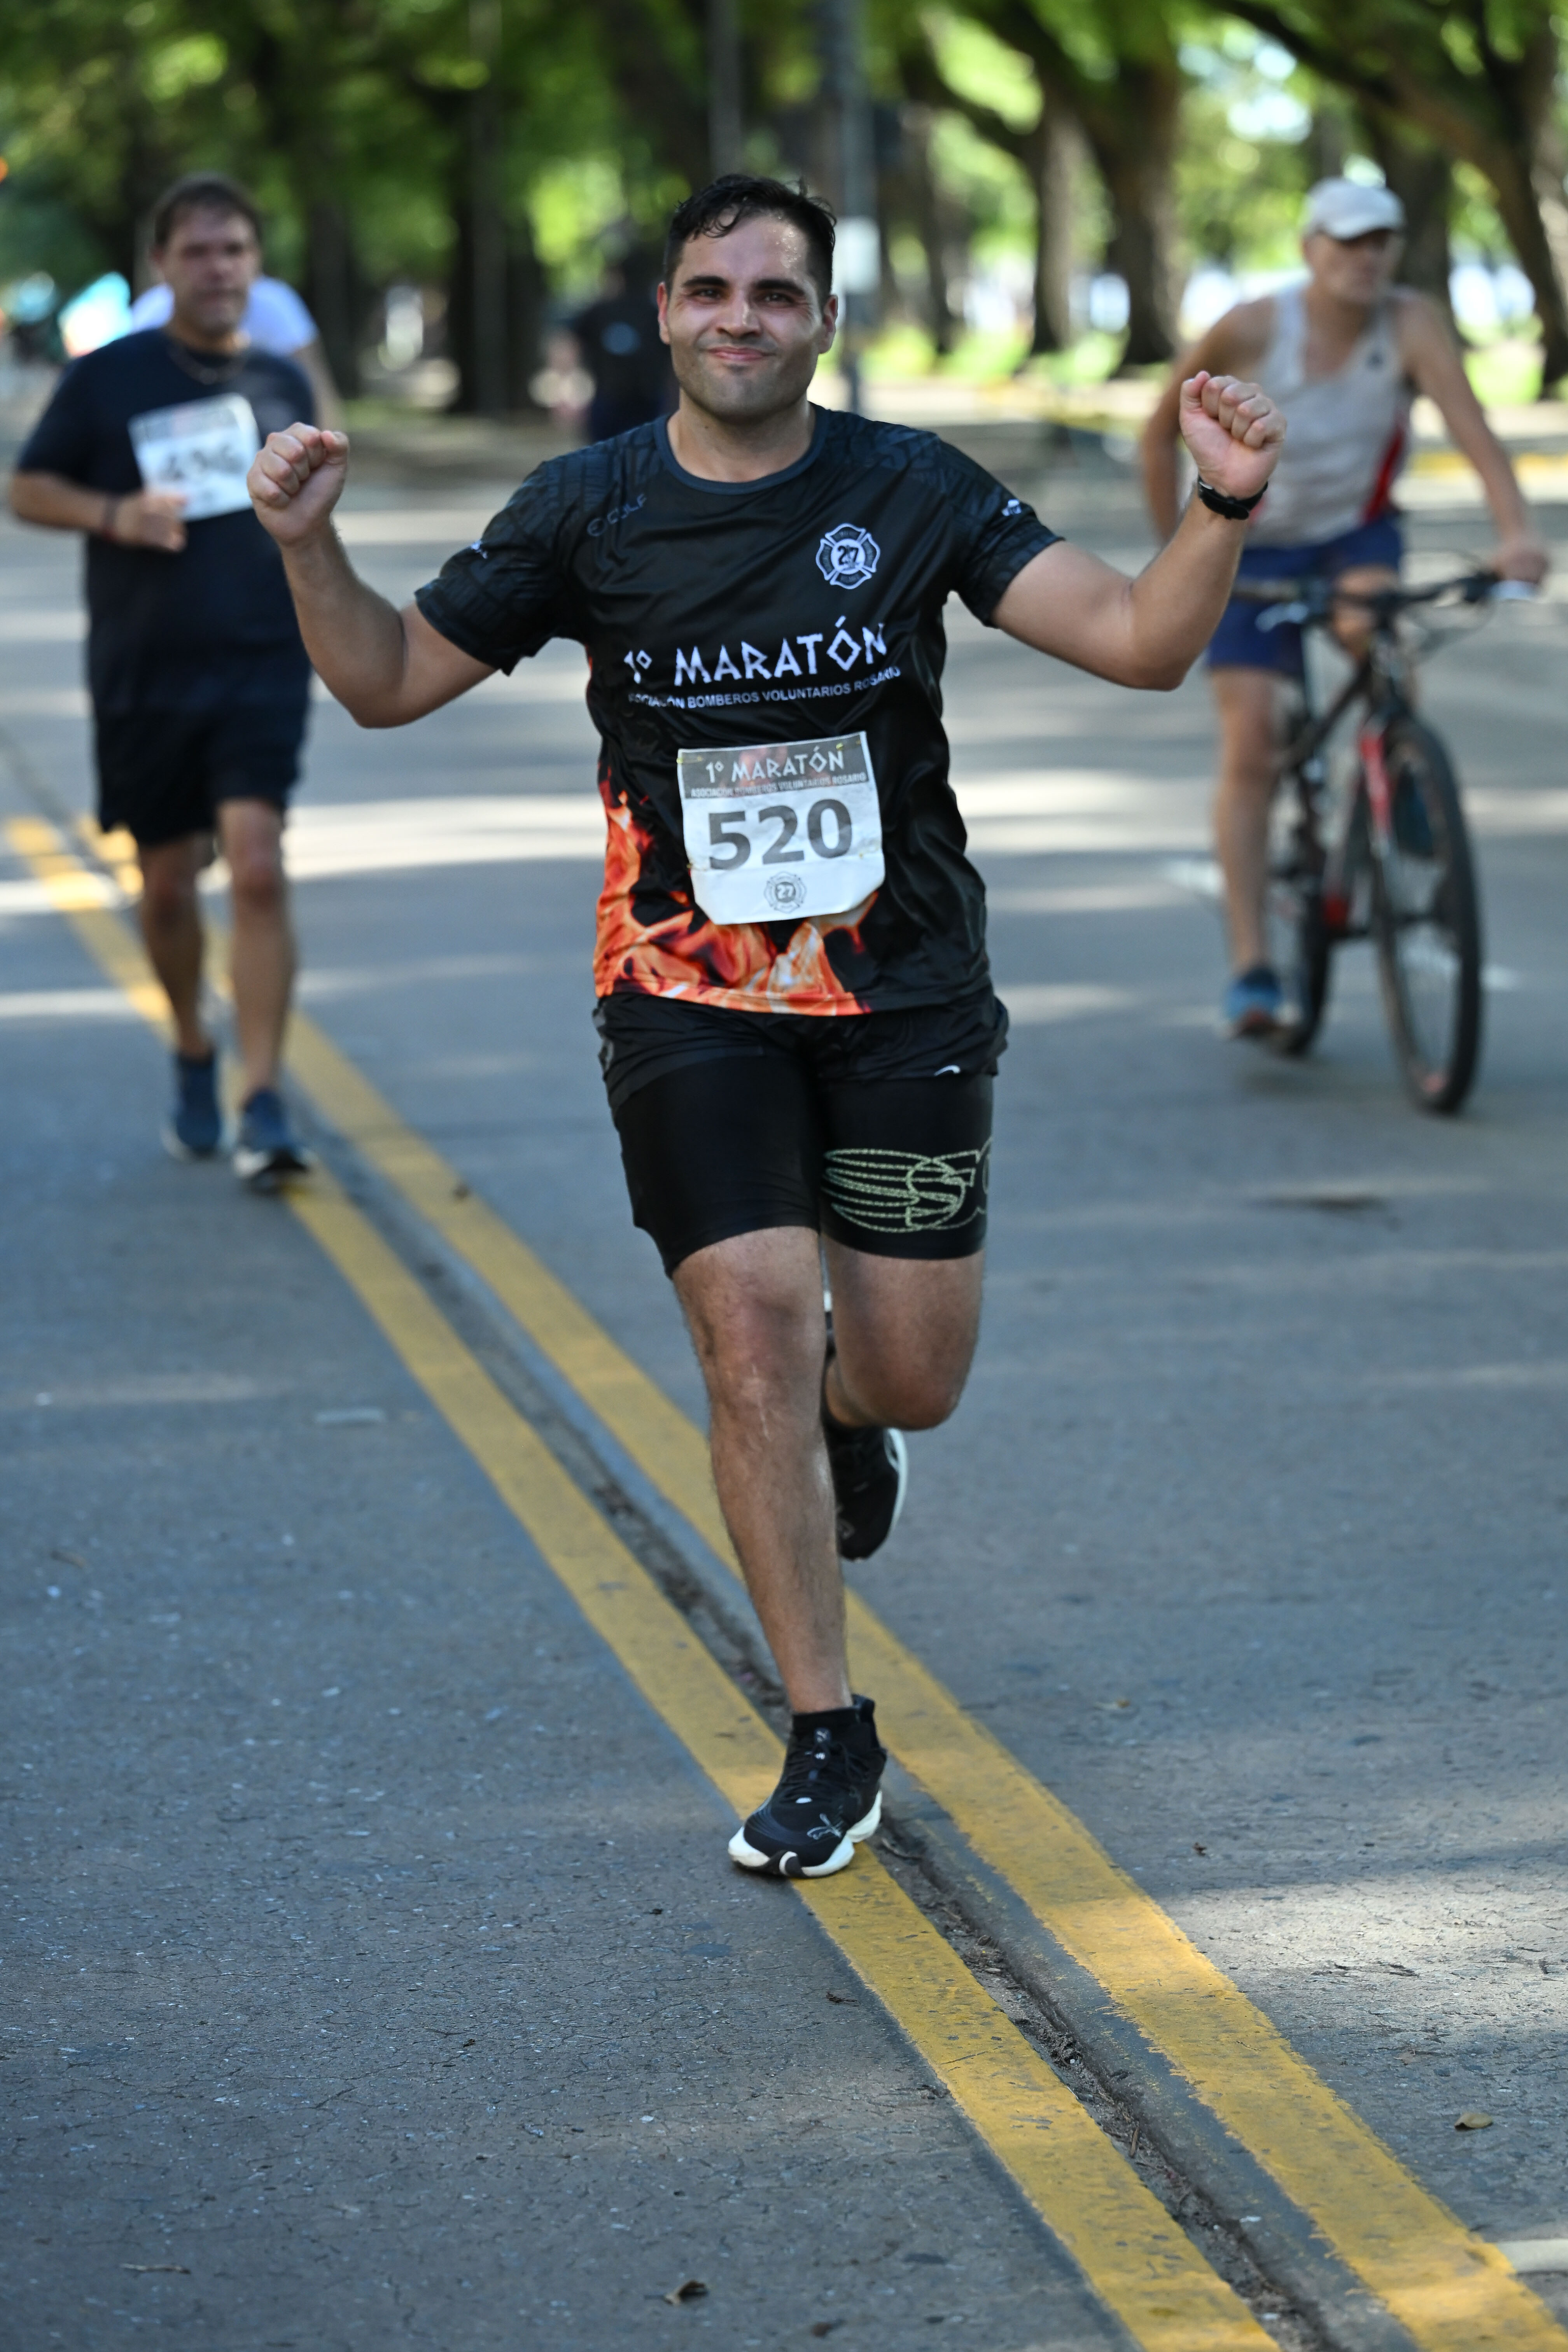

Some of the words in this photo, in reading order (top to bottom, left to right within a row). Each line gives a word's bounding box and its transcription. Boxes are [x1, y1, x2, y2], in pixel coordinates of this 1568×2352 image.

[838, 545, 859, 566] 27
[674, 615, 887, 686] MARATÓN
[687, 691, 760, 709] BOMBEROS
[761, 682, 851, 701] VOLUNTARIOS
[731, 746, 845, 783] MARATÓN
[708, 798, 852, 870] 520
[777, 884, 794, 899] 27
